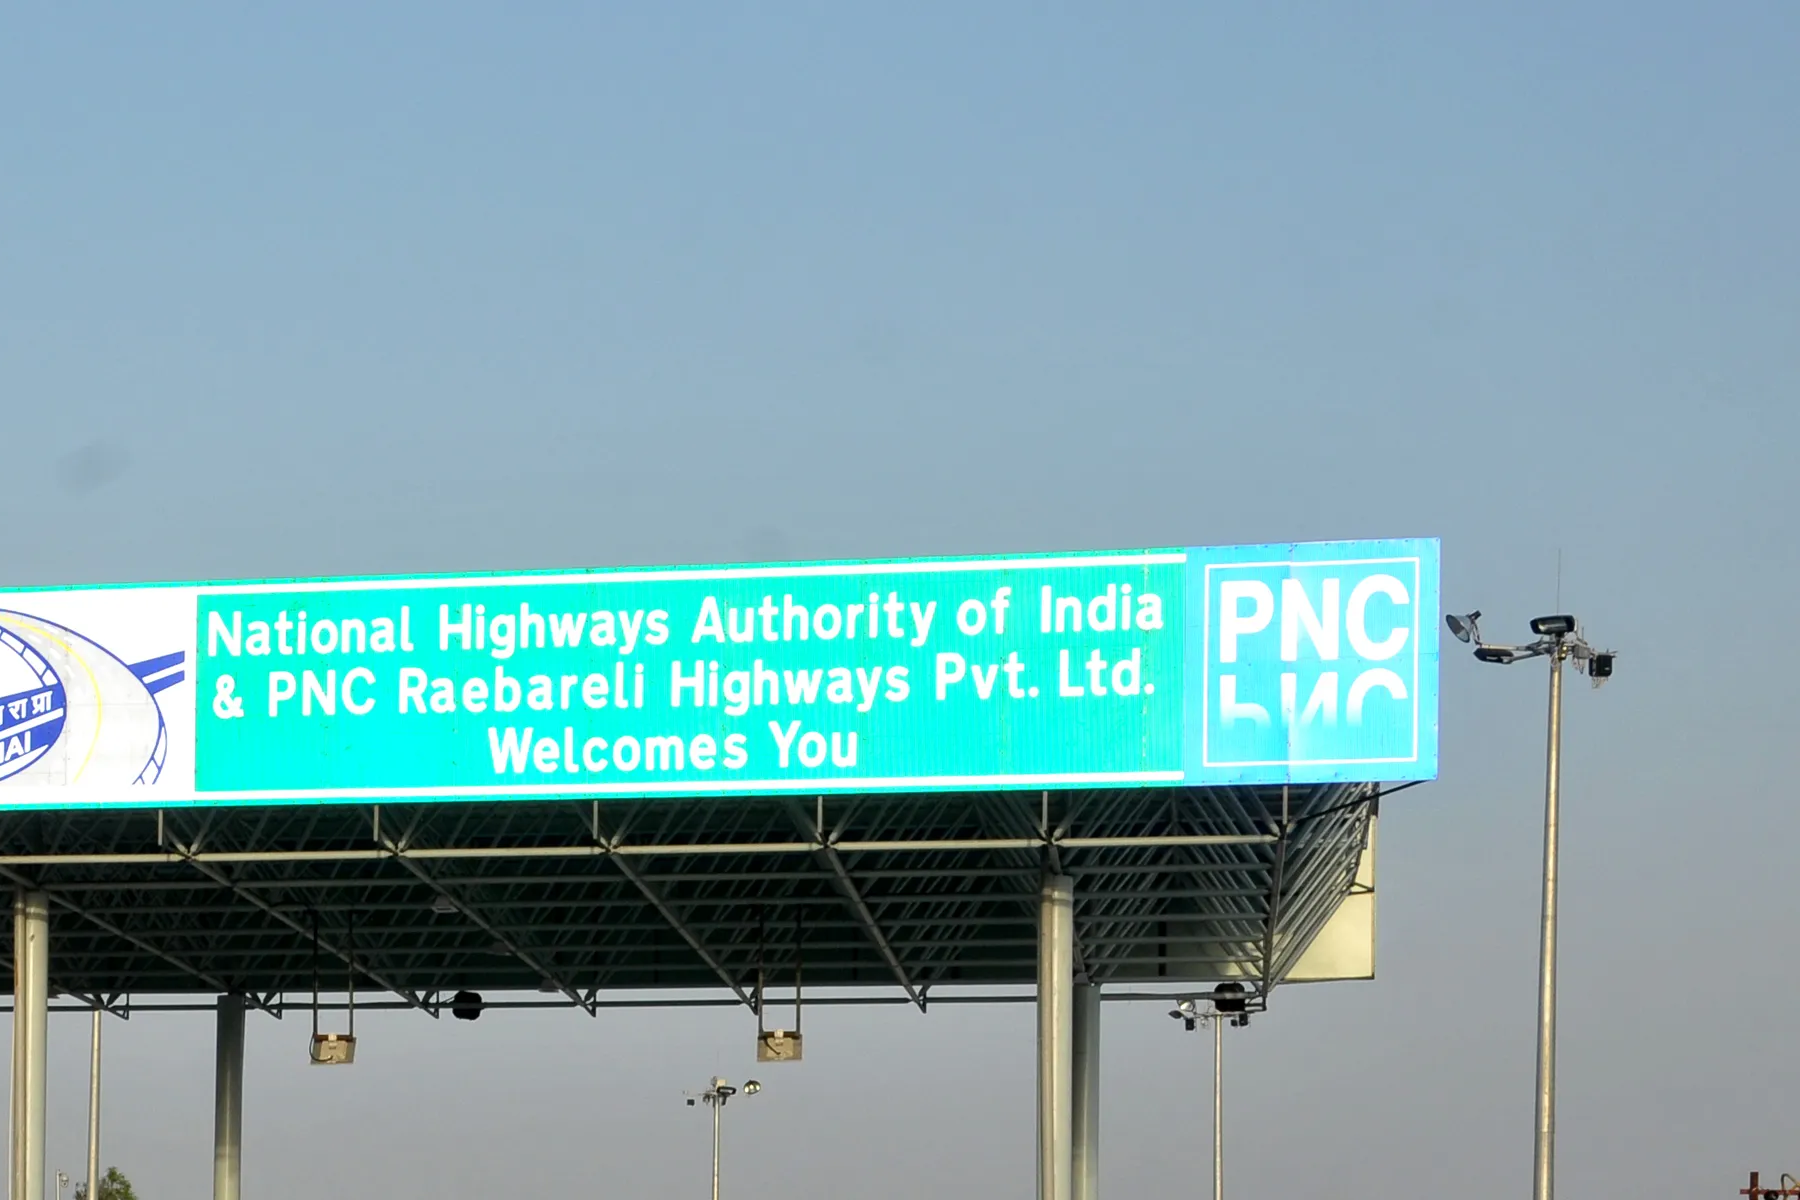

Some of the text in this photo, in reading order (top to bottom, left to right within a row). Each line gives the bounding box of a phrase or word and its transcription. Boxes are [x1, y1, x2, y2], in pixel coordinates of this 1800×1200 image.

[209, 584, 1163, 658] National Highways Authority of India
[1220, 574, 1409, 662] PNC
[8, 698, 28, 720] रा
[214, 648, 1154, 718] & PNC Raebareli Highways Pvt. Ltd.
[489, 721, 856, 773] Welcomes You
